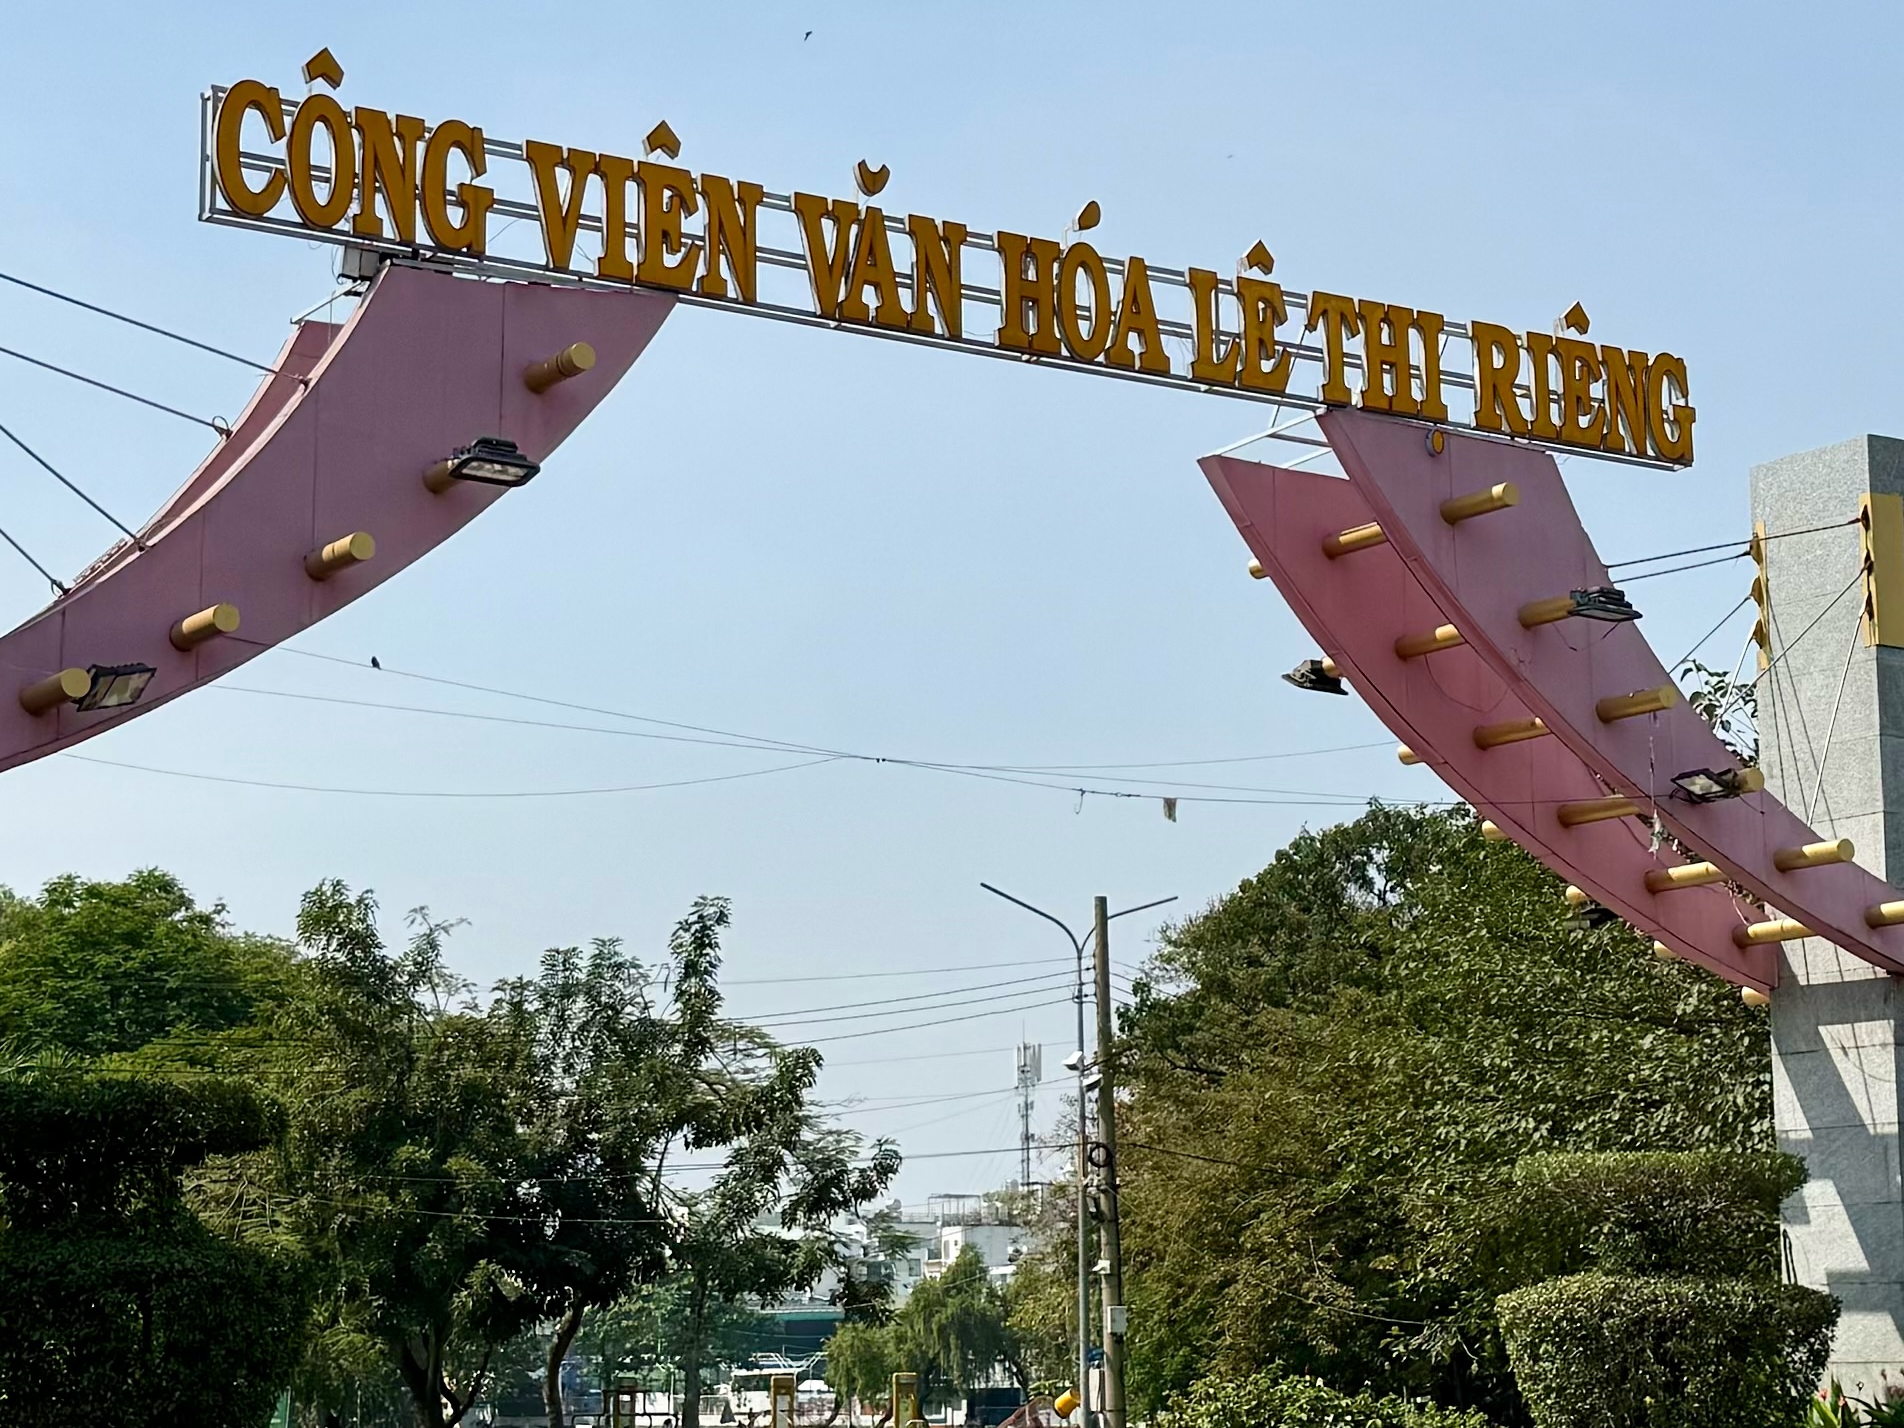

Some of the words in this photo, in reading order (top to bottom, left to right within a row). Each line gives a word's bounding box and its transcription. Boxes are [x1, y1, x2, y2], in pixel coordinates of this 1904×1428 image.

[212, 46, 495, 255] CÔNG
[523, 119, 764, 303] VIÊN
[792, 159, 966, 339] VĂN
[993, 200, 1171, 375] HÓA
[1185, 239, 1293, 394] LÊ
[1468, 301, 1696, 466] RIÊNG
